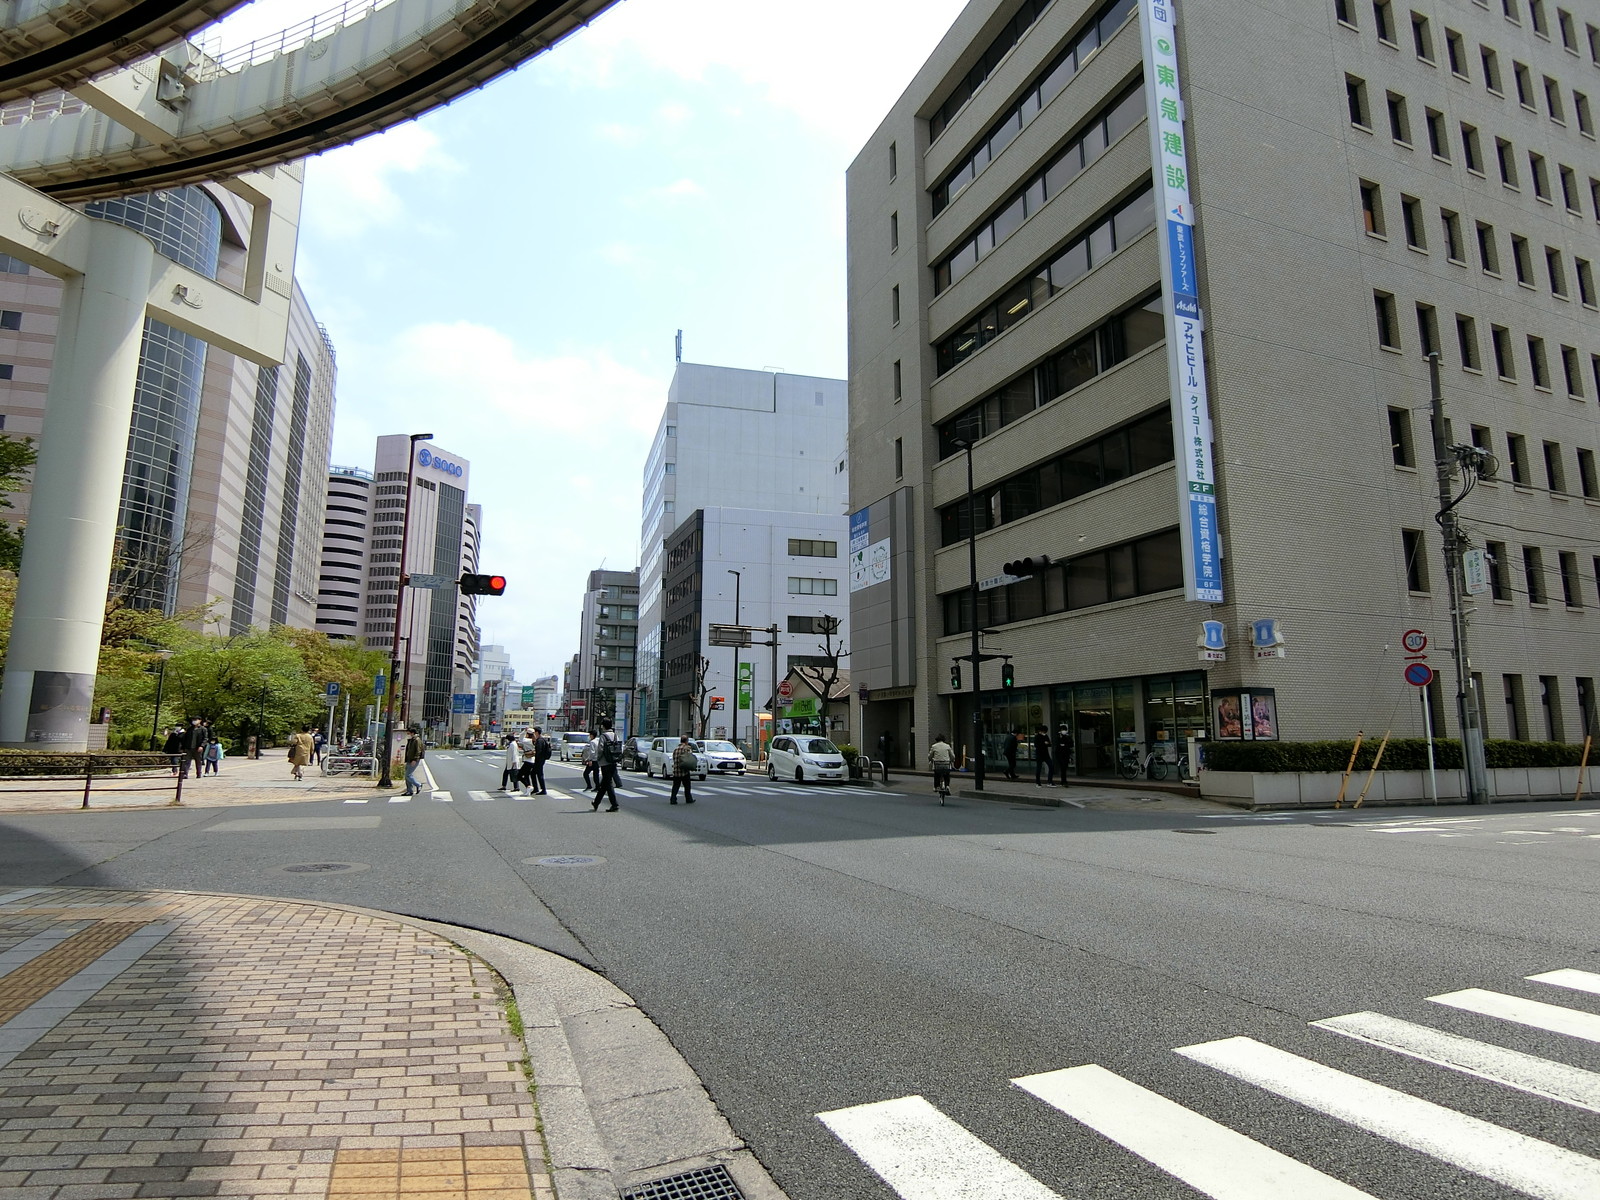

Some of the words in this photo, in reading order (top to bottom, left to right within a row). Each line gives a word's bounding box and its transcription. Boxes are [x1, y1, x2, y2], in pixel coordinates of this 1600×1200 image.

[1156, 64, 1186, 191] 東急建設
[1176, 300, 1197, 313] Asahi
[1183, 321, 1198, 388] アサヒビール
[1191, 395, 1206, 481] タイヨー株式会社
[432, 456, 463, 477] SOGO
[1198, 504, 1213, 578] 総合資格学院
[413, 575, 453, 584] センシティ
[1407, 635, 1422, 647] 30
[329, 683, 338, 694] P
